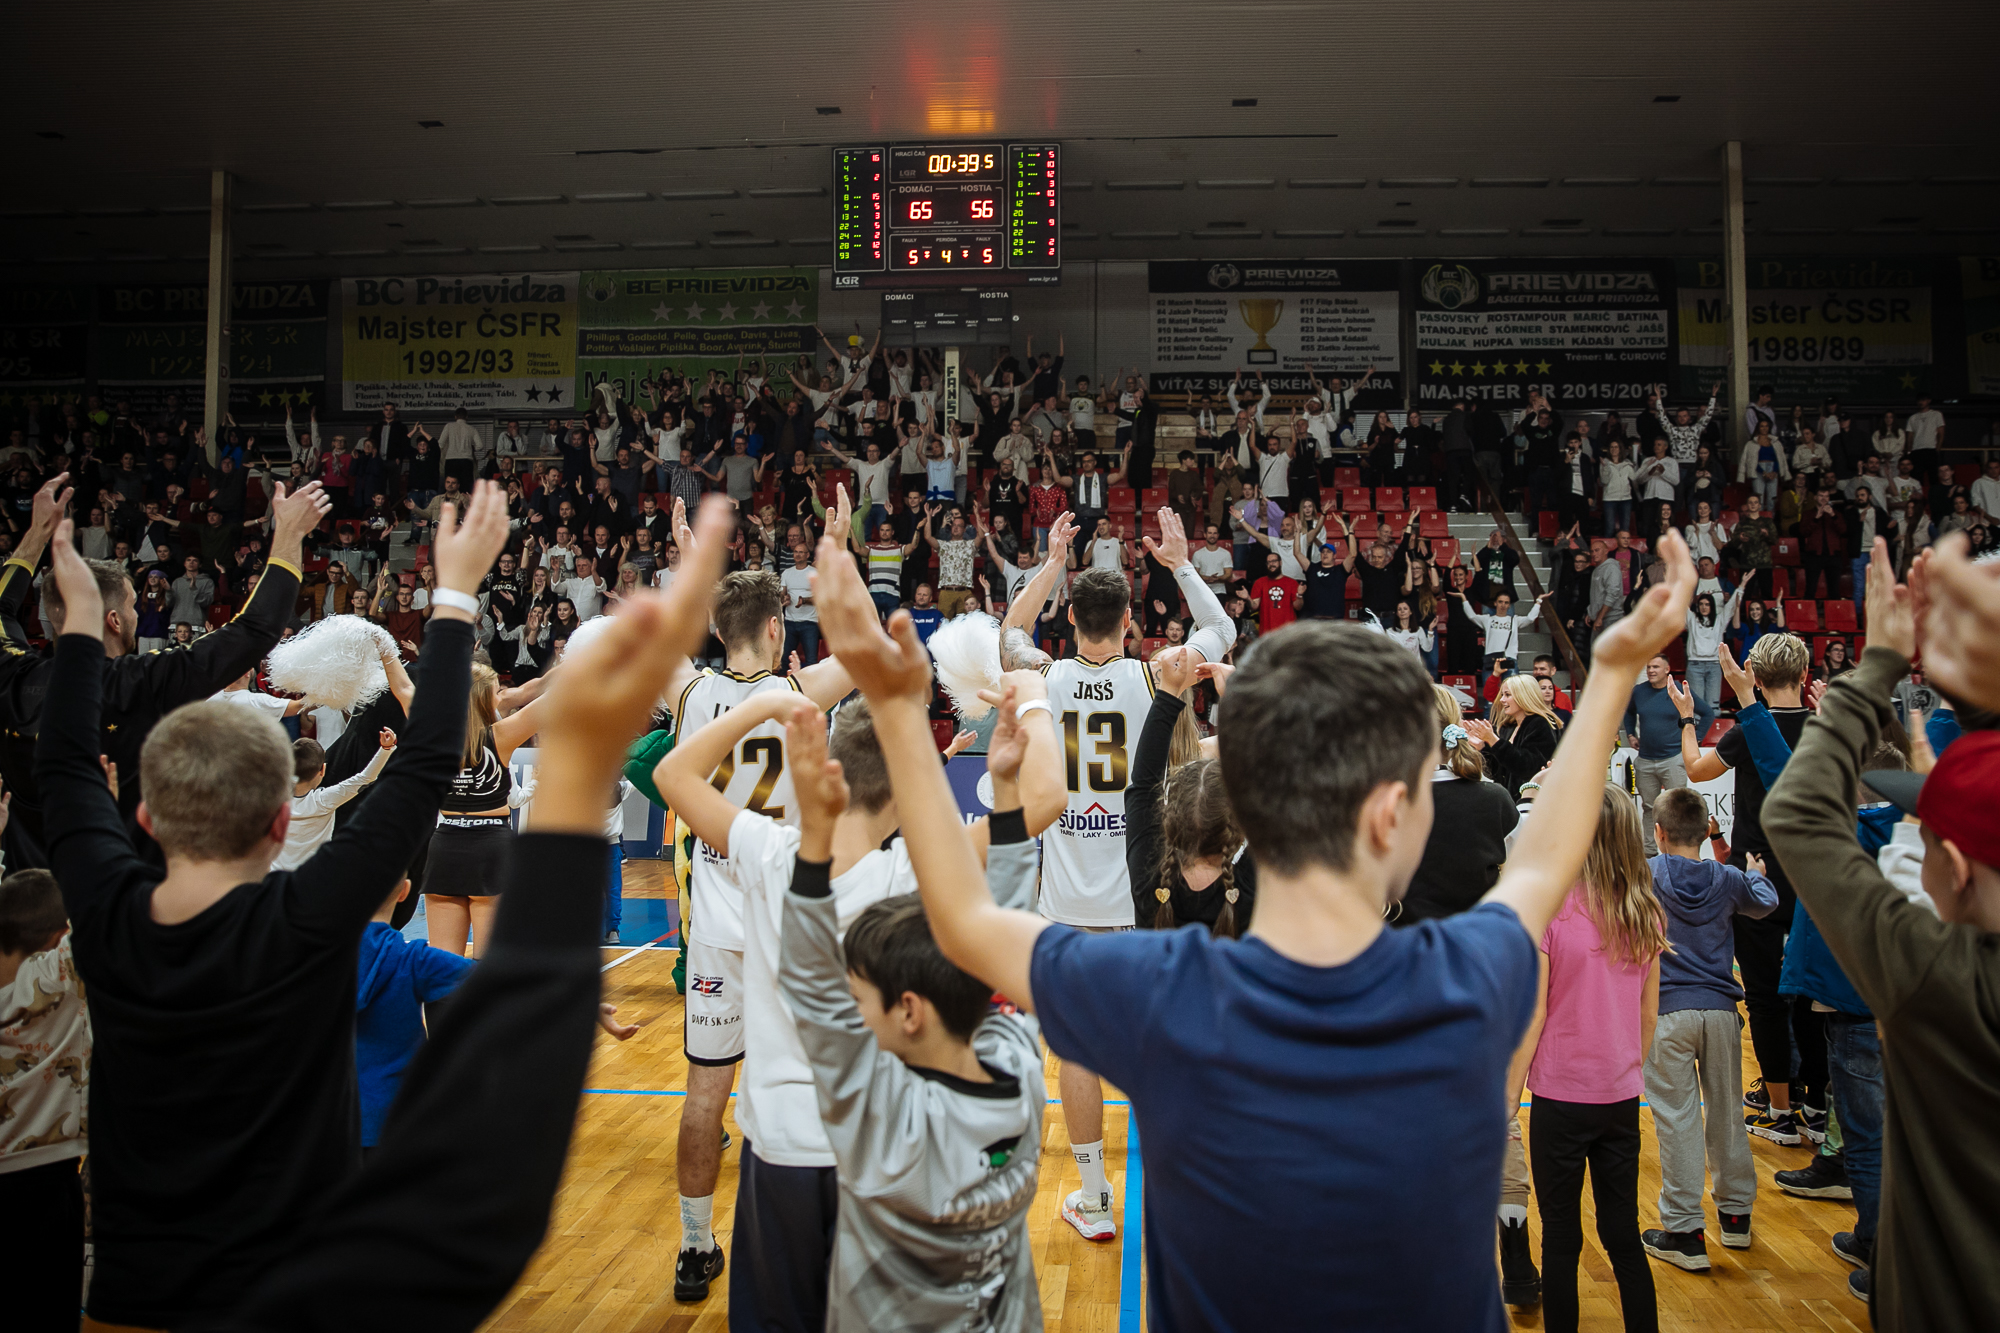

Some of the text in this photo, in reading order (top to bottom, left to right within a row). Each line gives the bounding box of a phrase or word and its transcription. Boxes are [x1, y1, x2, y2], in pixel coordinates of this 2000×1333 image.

[899, 184, 933, 193] DOMÁCI
[909, 199, 994, 220] 65 56
[872, 241, 880, 249] 12
[1048, 238, 1055, 246] 2
[908, 248, 993, 265] 5 4 5
[1048, 248, 1055, 256] 2
[836, 276, 859, 286] LGR
[1246, 269, 1338, 278] PRIEVIDZA
[1698, 261, 1914, 288] B Prievidza
[626, 276, 811, 295] BC PRIEVIDZA
[1488, 273, 1656, 291] PRIEVIDZA
[114, 285, 316, 311] BC PRIVIDZA
[355, 275, 566, 306] BC Prievidza
[1487, 294, 1660, 304] BASKETBALL CLUB PRIEVIDZA
[1698, 292, 1912, 326] Mster ČSSR
[1420, 312, 1659, 323] PASOVSKÝ ROSTAMPOUR BATINA
[358, 308, 562, 345] Majster ČSFR
[1419, 323, 1664, 335] STANOJEVIĆ KÖRNER STAMENKOVIĆ JAŠŠ
[1420, 336, 1666, 347] HULJAK HUPKA WISSEH KÁDAŠI VOJTEK
[1748, 336, 1864, 362] 1988/89
[403, 349, 514, 375] 1992/93
[1565, 353, 1602, 361] Tréner:
[1158, 377, 1204, 390] VÍŤAZ
[1420, 384, 1520, 400] MAJSTER
[1562, 384, 1668, 399] 2015/2016
[1074, 679, 1114, 700] JAŠŠ
[1059, 710, 1128, 793] 13
[711, 1017, 722, 1026] SK
